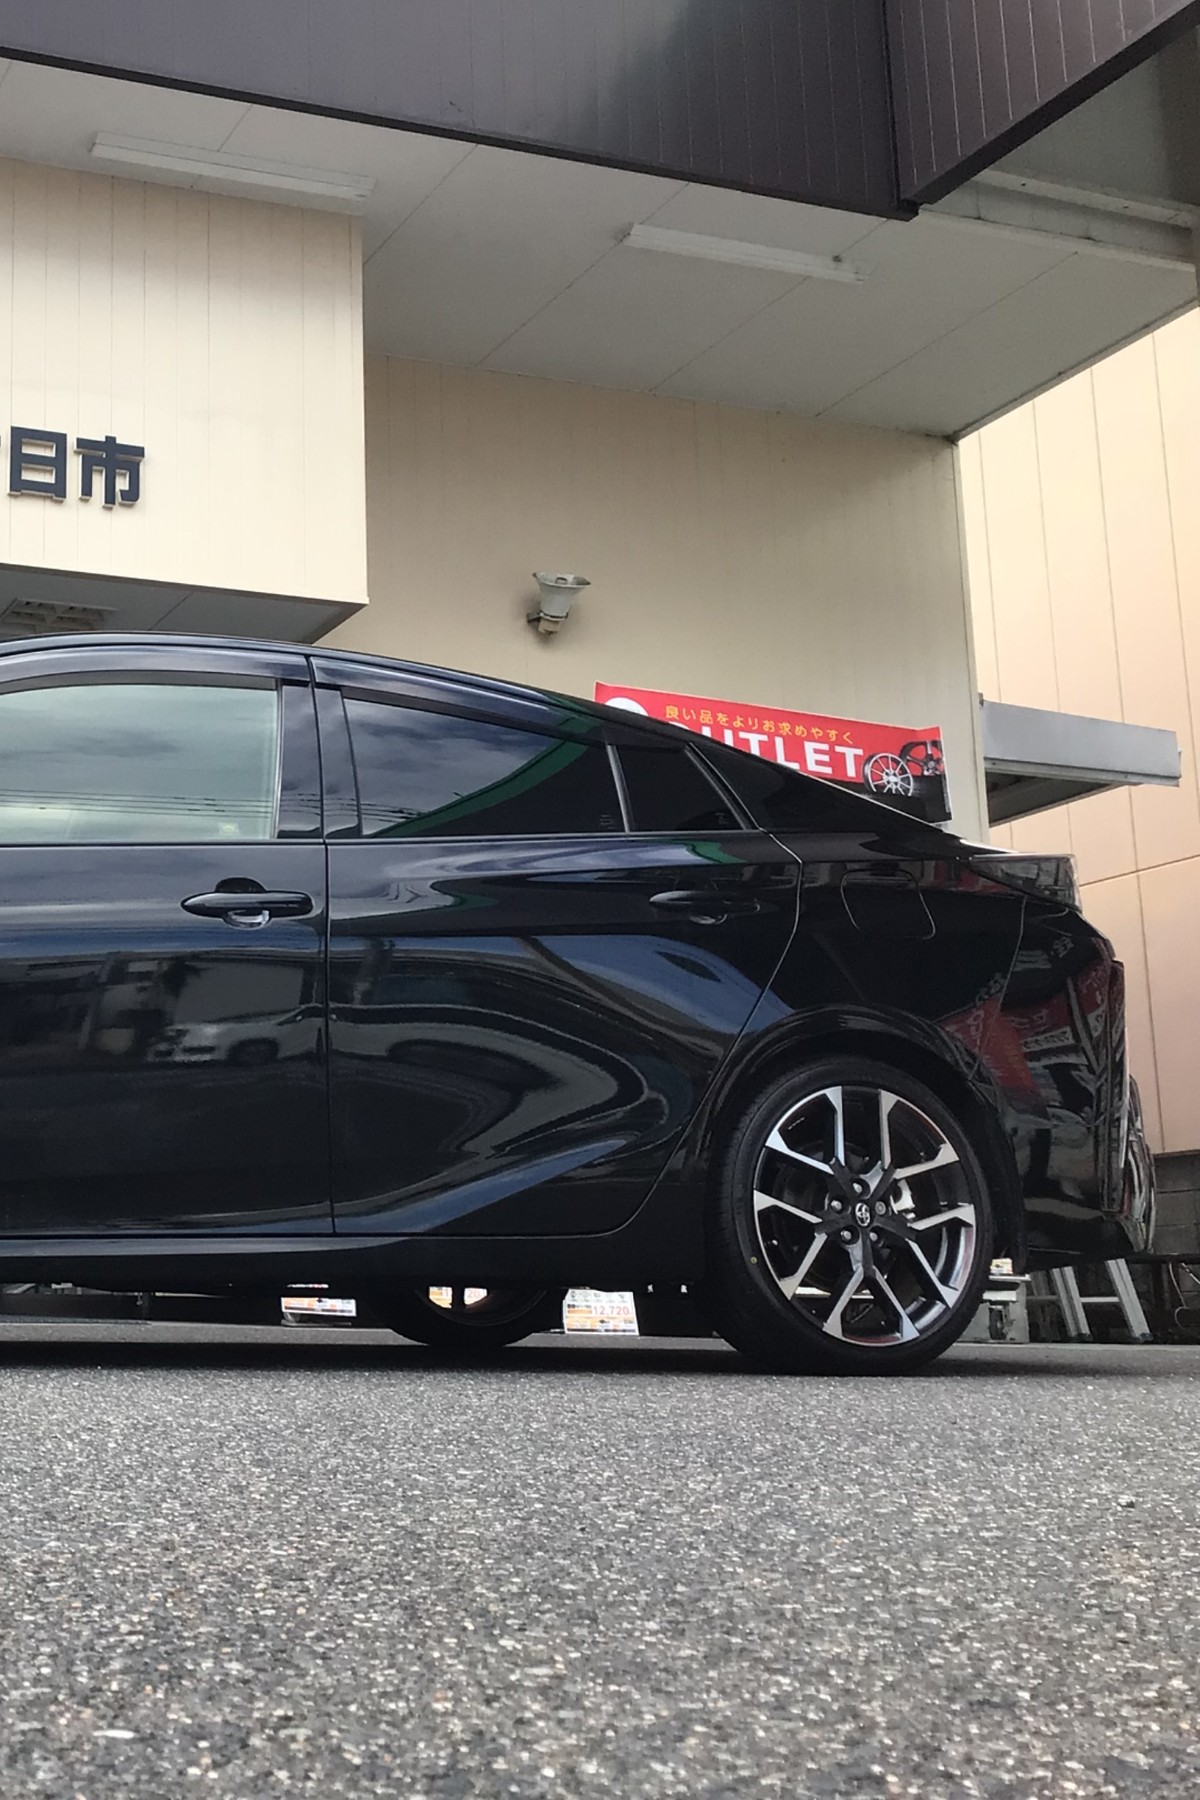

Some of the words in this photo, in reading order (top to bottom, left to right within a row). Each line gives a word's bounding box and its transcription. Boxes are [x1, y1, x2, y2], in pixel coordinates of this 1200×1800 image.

[665, 705, 854, 744] 良い品をよりお求めやすく
